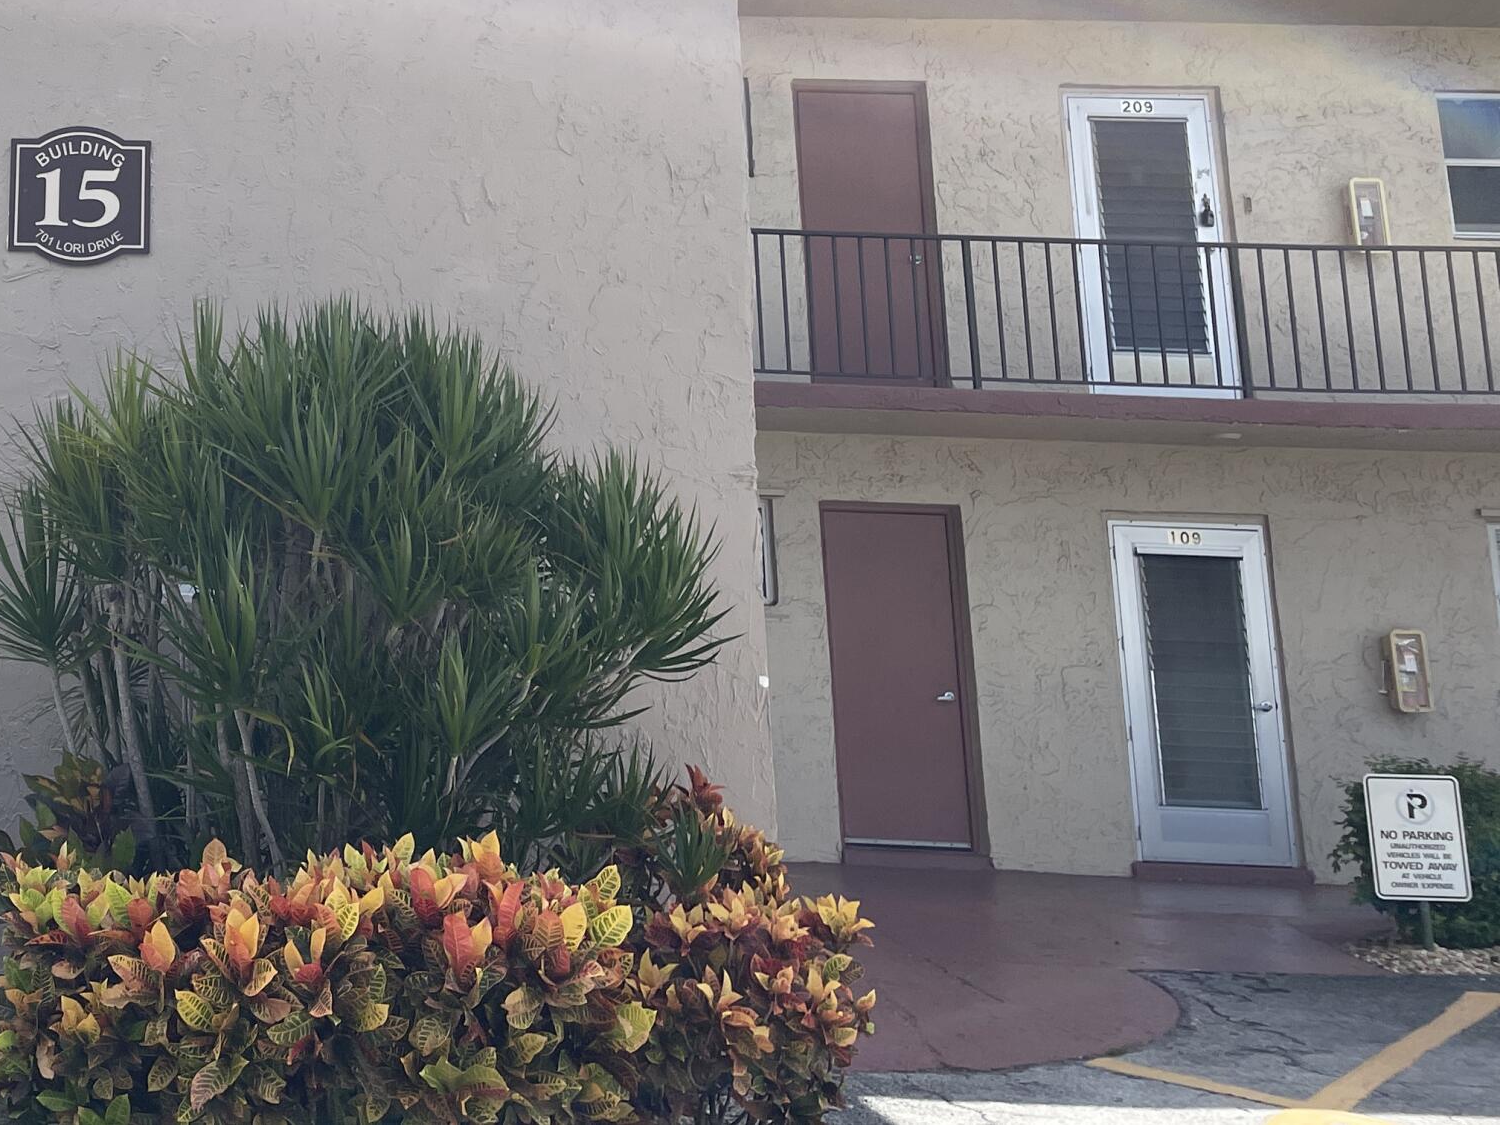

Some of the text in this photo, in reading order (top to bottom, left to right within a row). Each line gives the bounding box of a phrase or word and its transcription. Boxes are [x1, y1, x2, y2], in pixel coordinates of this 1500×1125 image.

[1122, 100, 1153, 113] 209
[34, 140, 125, 168] BUILDING
[35, 167, 120, 228] 15
[35, 228, 124, 254] 701 LORI DRIVE
[1170, 531, 1202, 545] 109
[1380, 830, 1454, 842] NO PARKING
[1390, 843, 1446, 851] UNAUTHORIZED
[1386, 852, 1421, 860] VEHICLES
[1423, 852, 1440, 860] WILL
[1382, 861, 1458, 872] TOWED AWAY
[1413, 873, 1443, 881] VEHICLE
